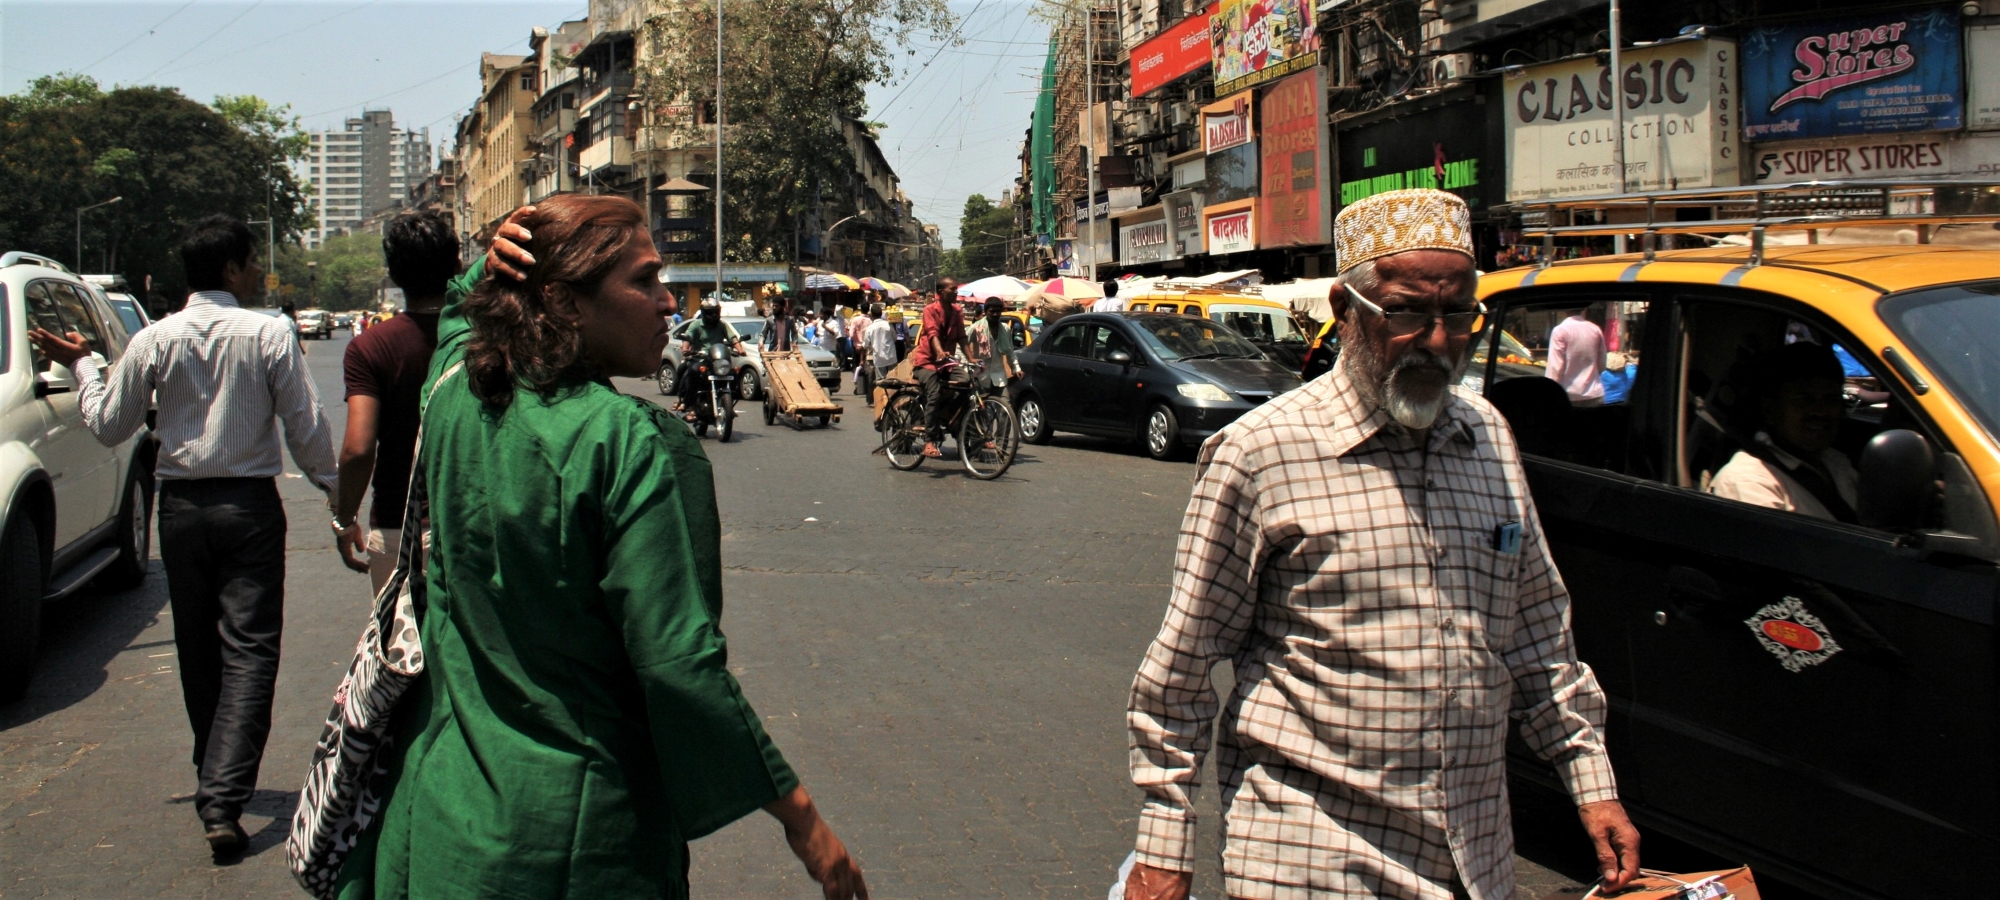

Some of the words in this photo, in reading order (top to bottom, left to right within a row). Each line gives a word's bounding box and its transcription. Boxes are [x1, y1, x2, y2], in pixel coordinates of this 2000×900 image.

[1793, 22, 1906, 68] Super
[1793, 44, 1914, 81] Stores
[1264, 81, 1315, 130] DINA
[1517, 58, 1695, 123] CLASSIC
[1717, 50, 1731, 159] CLASSIC
[1209, 116, 1247, 148] BADSHAH
[1264, 126, 1316, 157] Stores
[1568, 118, 1695, 146] COLLCTION
[1407, 167, 1438, 190] KIDS
[1444, 159, 1480, 190] ZONE
[1783, 147, 1854, 175] SUPER
[1859, 142, 1943, 171] STORES
[1212, 214, 1249, 241] बादशाह
